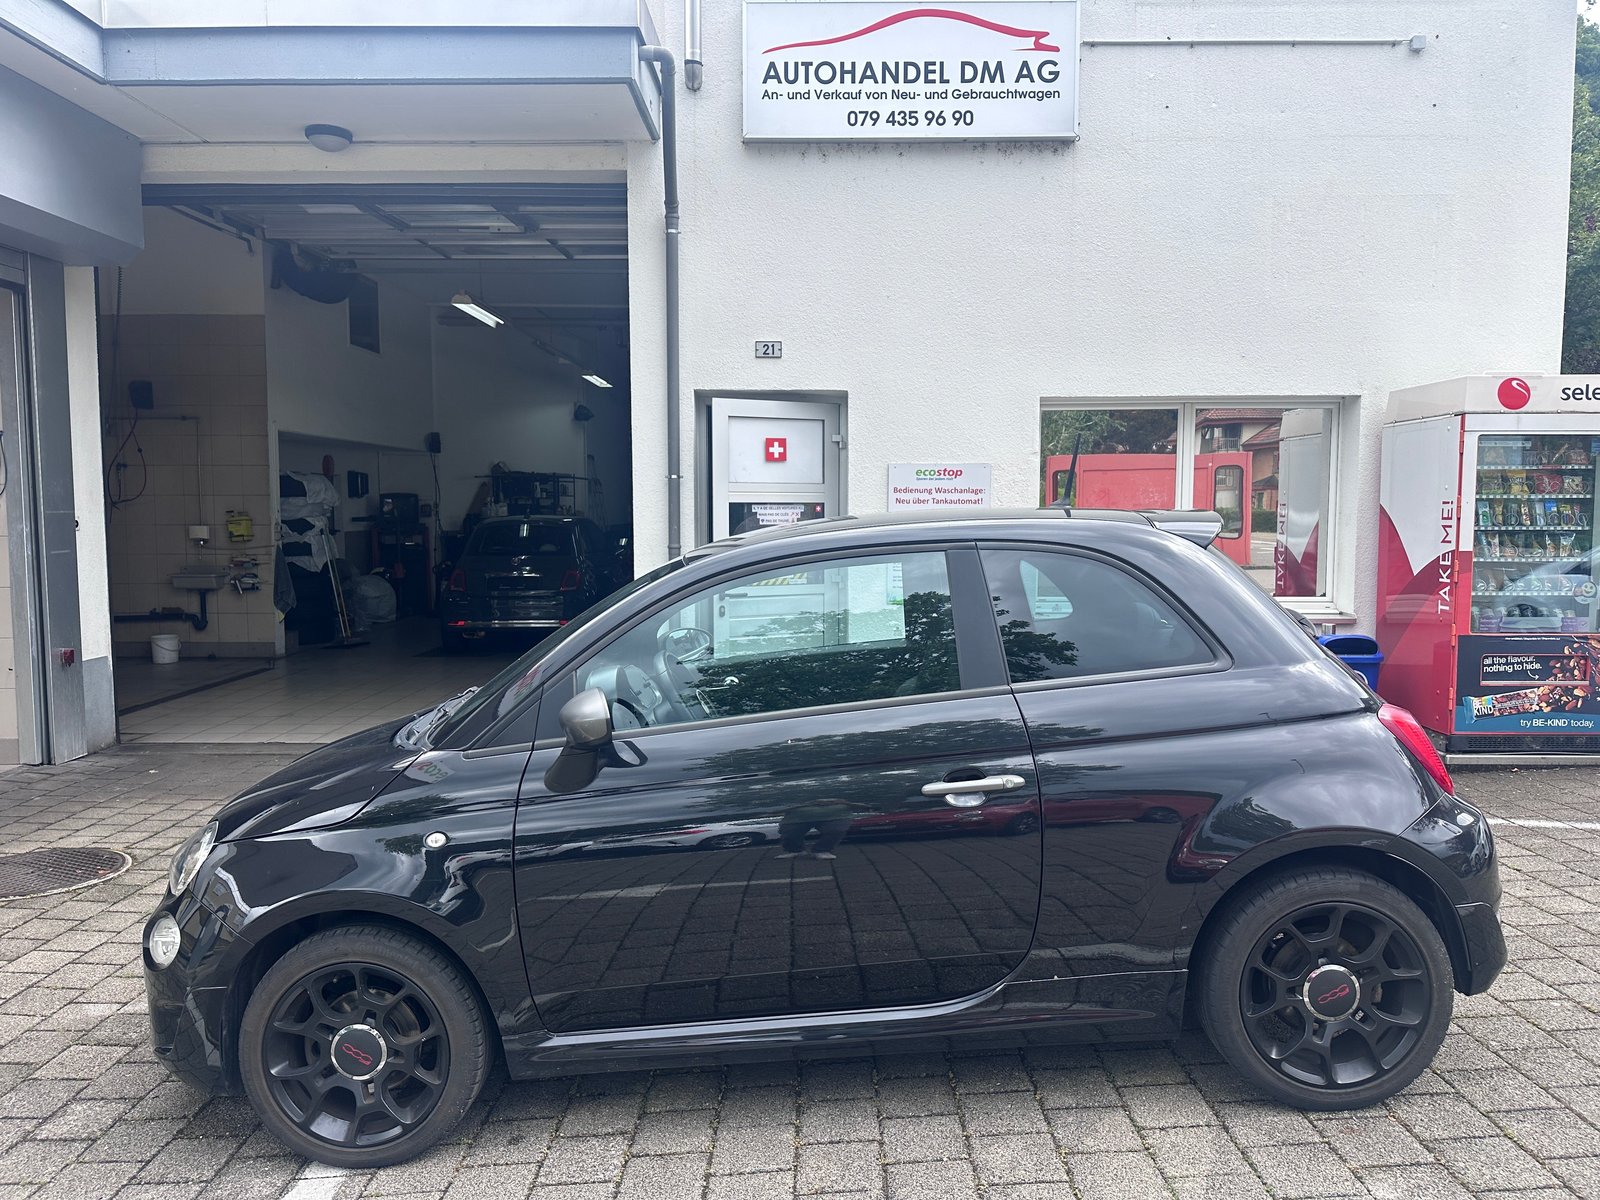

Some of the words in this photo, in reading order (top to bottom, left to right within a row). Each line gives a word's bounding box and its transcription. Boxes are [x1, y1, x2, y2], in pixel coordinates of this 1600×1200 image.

[761, 60, 950, 85] AUTOHANDEL
[960, 60, 1005, 84] DM
[1014, 59, 1061, 84] AG
[761, 89, 784, 100] An-
[787, 89, 811, 100] und
[814, 89, 862, 100] Verkauf
[865, 91, 888, 100] von
[891, 89, 921, 100] Neu-
[925, 89, 948, 99] und
[951, 88, 1061, 101] Gebrauchtwagen
[847, 110, 880, 127] 079
[885, 110, 919, 127] 435
[924, 110, 947, 127] 96
[951, 110, 974, 127] 90
[762, 343, 776, 356] 21
[915, 467, 963, 479] ecostop
[893, 486, 933, 495] Bedienung
[934, 486, 986, 495] Waschanlage:
[895, 497, 911, 505] Neu
[912, 497, 929, 505] über
[931, 497, 984, 505] Tankautomat!
[1440, 500, 1454, 543] ME!
[1438, 552, 1453, 614] TAKE
[1483, 656, 1493, 665] all
[1493, 655, 1506, 664] the
[1483, 664, 1513, 673] nothing
[1523, 662, 1542, 671] hide.
[1474, 705, 1494, 716] KIND
[1520, 719, 1531, 728] try
[1571, 719, 1595, 728] today.
